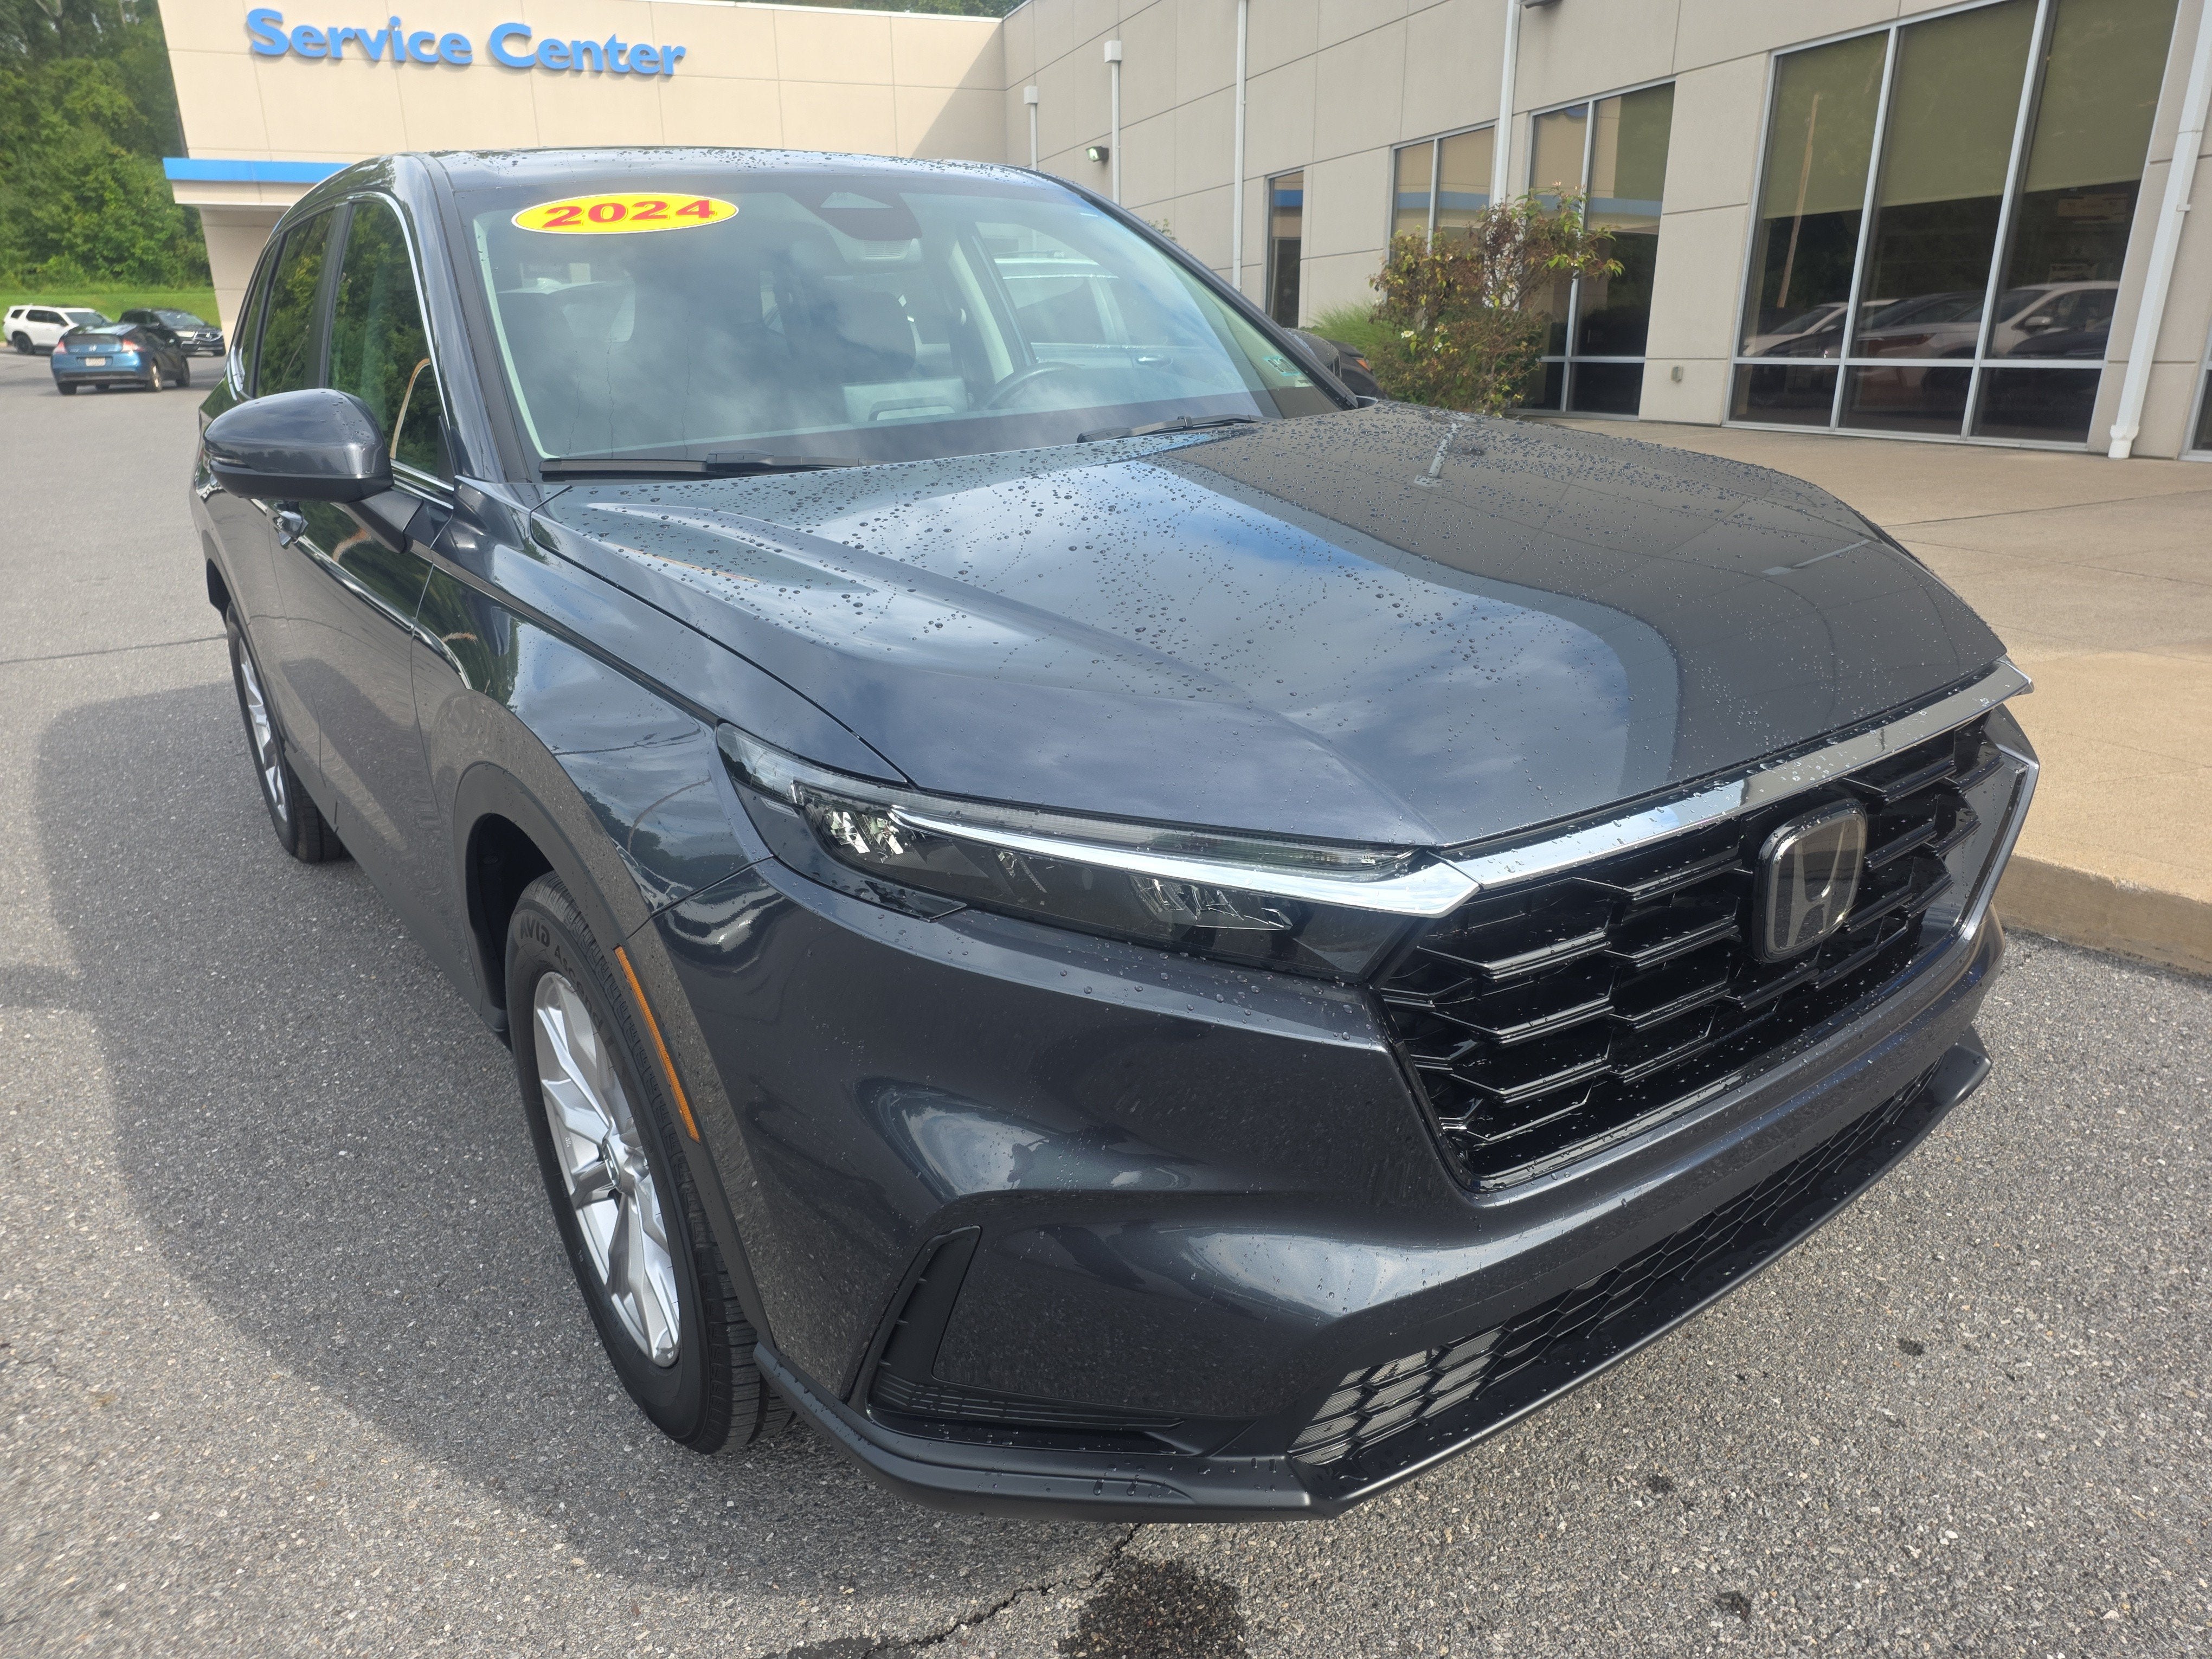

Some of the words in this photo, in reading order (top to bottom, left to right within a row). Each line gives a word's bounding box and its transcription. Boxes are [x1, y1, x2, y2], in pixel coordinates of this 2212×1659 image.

[246, 8, 472, 65] Service
[489, 23, 686, 75] Center
[542, 200, 715, 228] 2024
[520, 914, 550, 948] AVID
[554, 944, 603, 1030] Ascend
